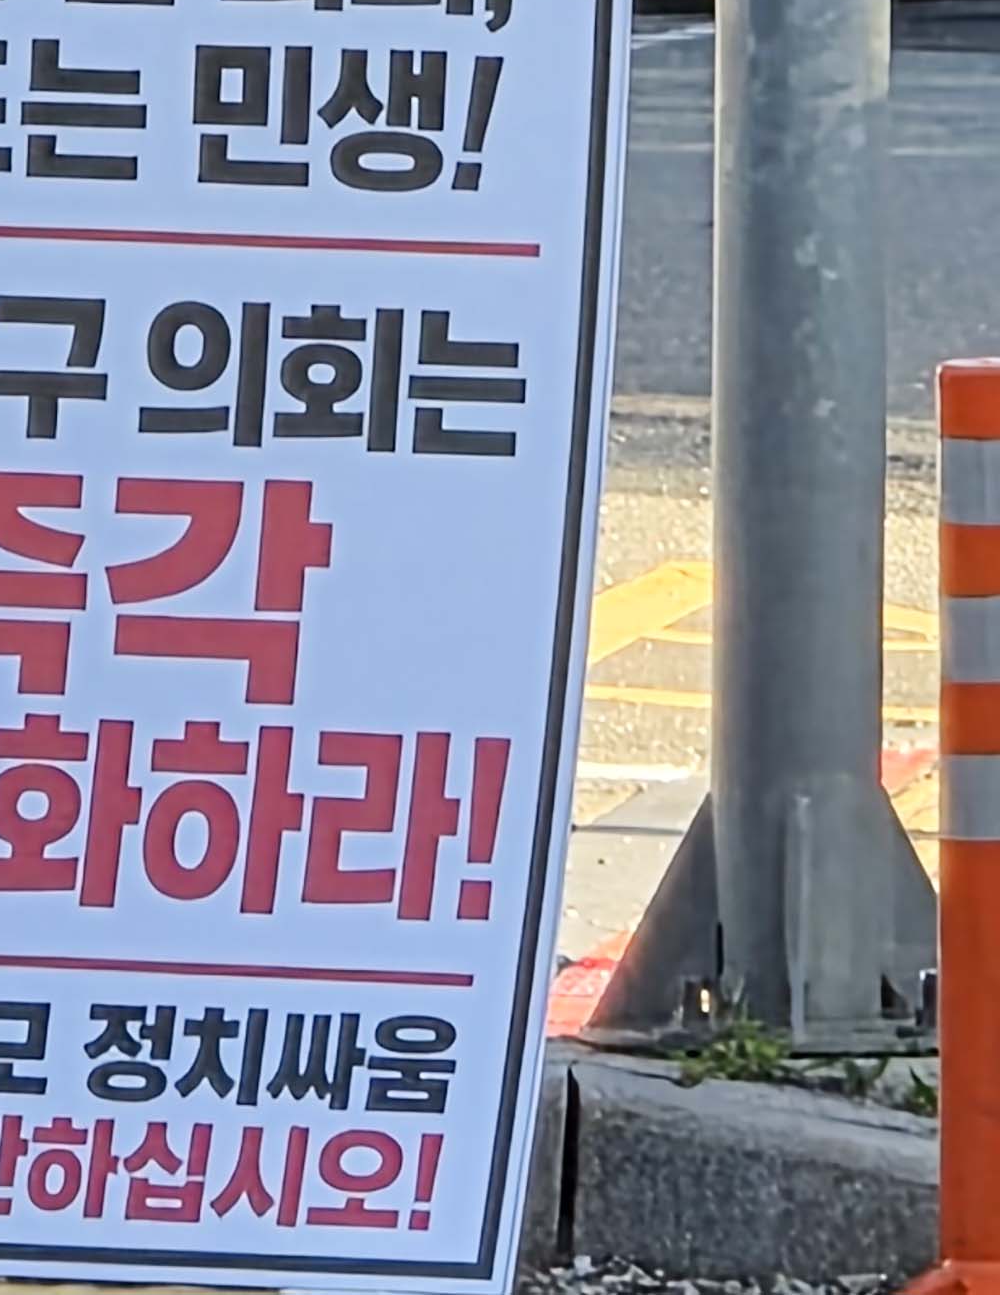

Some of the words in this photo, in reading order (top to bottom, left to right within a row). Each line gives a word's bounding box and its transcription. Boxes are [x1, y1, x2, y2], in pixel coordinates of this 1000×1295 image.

[193, 45, 503, 191] 민생!
[139, 302, 526, 456] 의회는
[84, 1004, 456, 1113] 정치싸움
